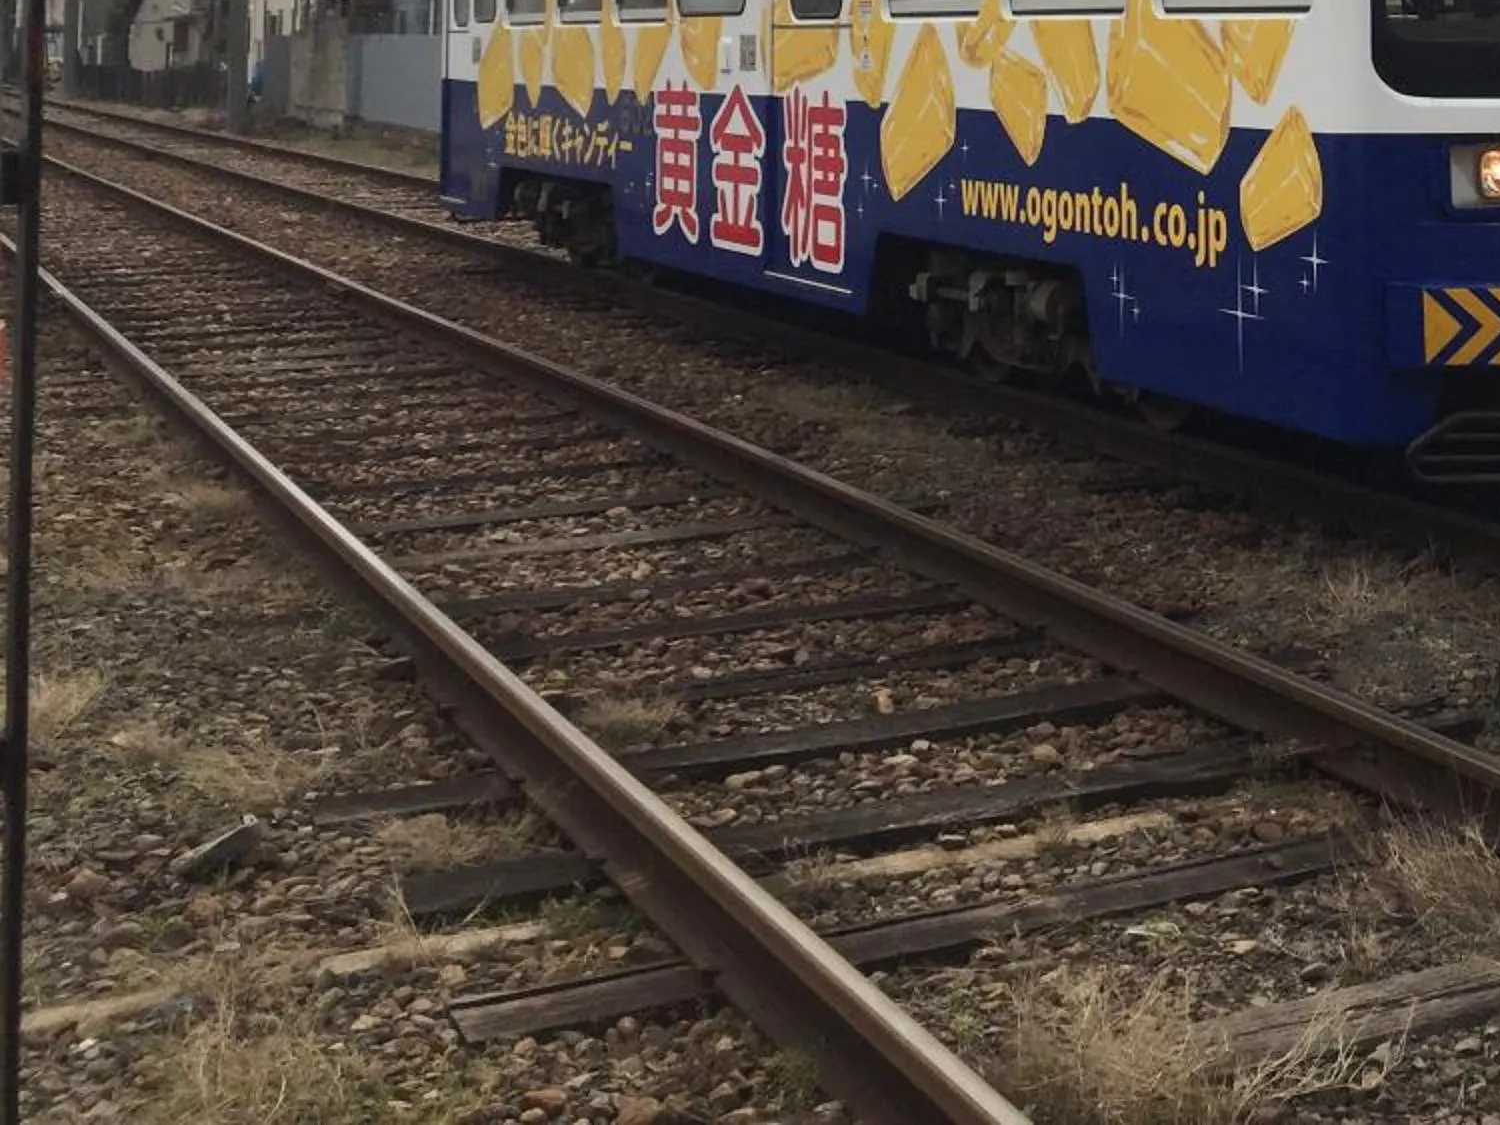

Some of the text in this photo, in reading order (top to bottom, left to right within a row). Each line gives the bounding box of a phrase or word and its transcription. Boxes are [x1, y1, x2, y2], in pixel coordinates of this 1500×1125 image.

[652, 78, 848, 274] 黄金糖
[960, 178, 1228, 267] www.ogontoh.co.jp
